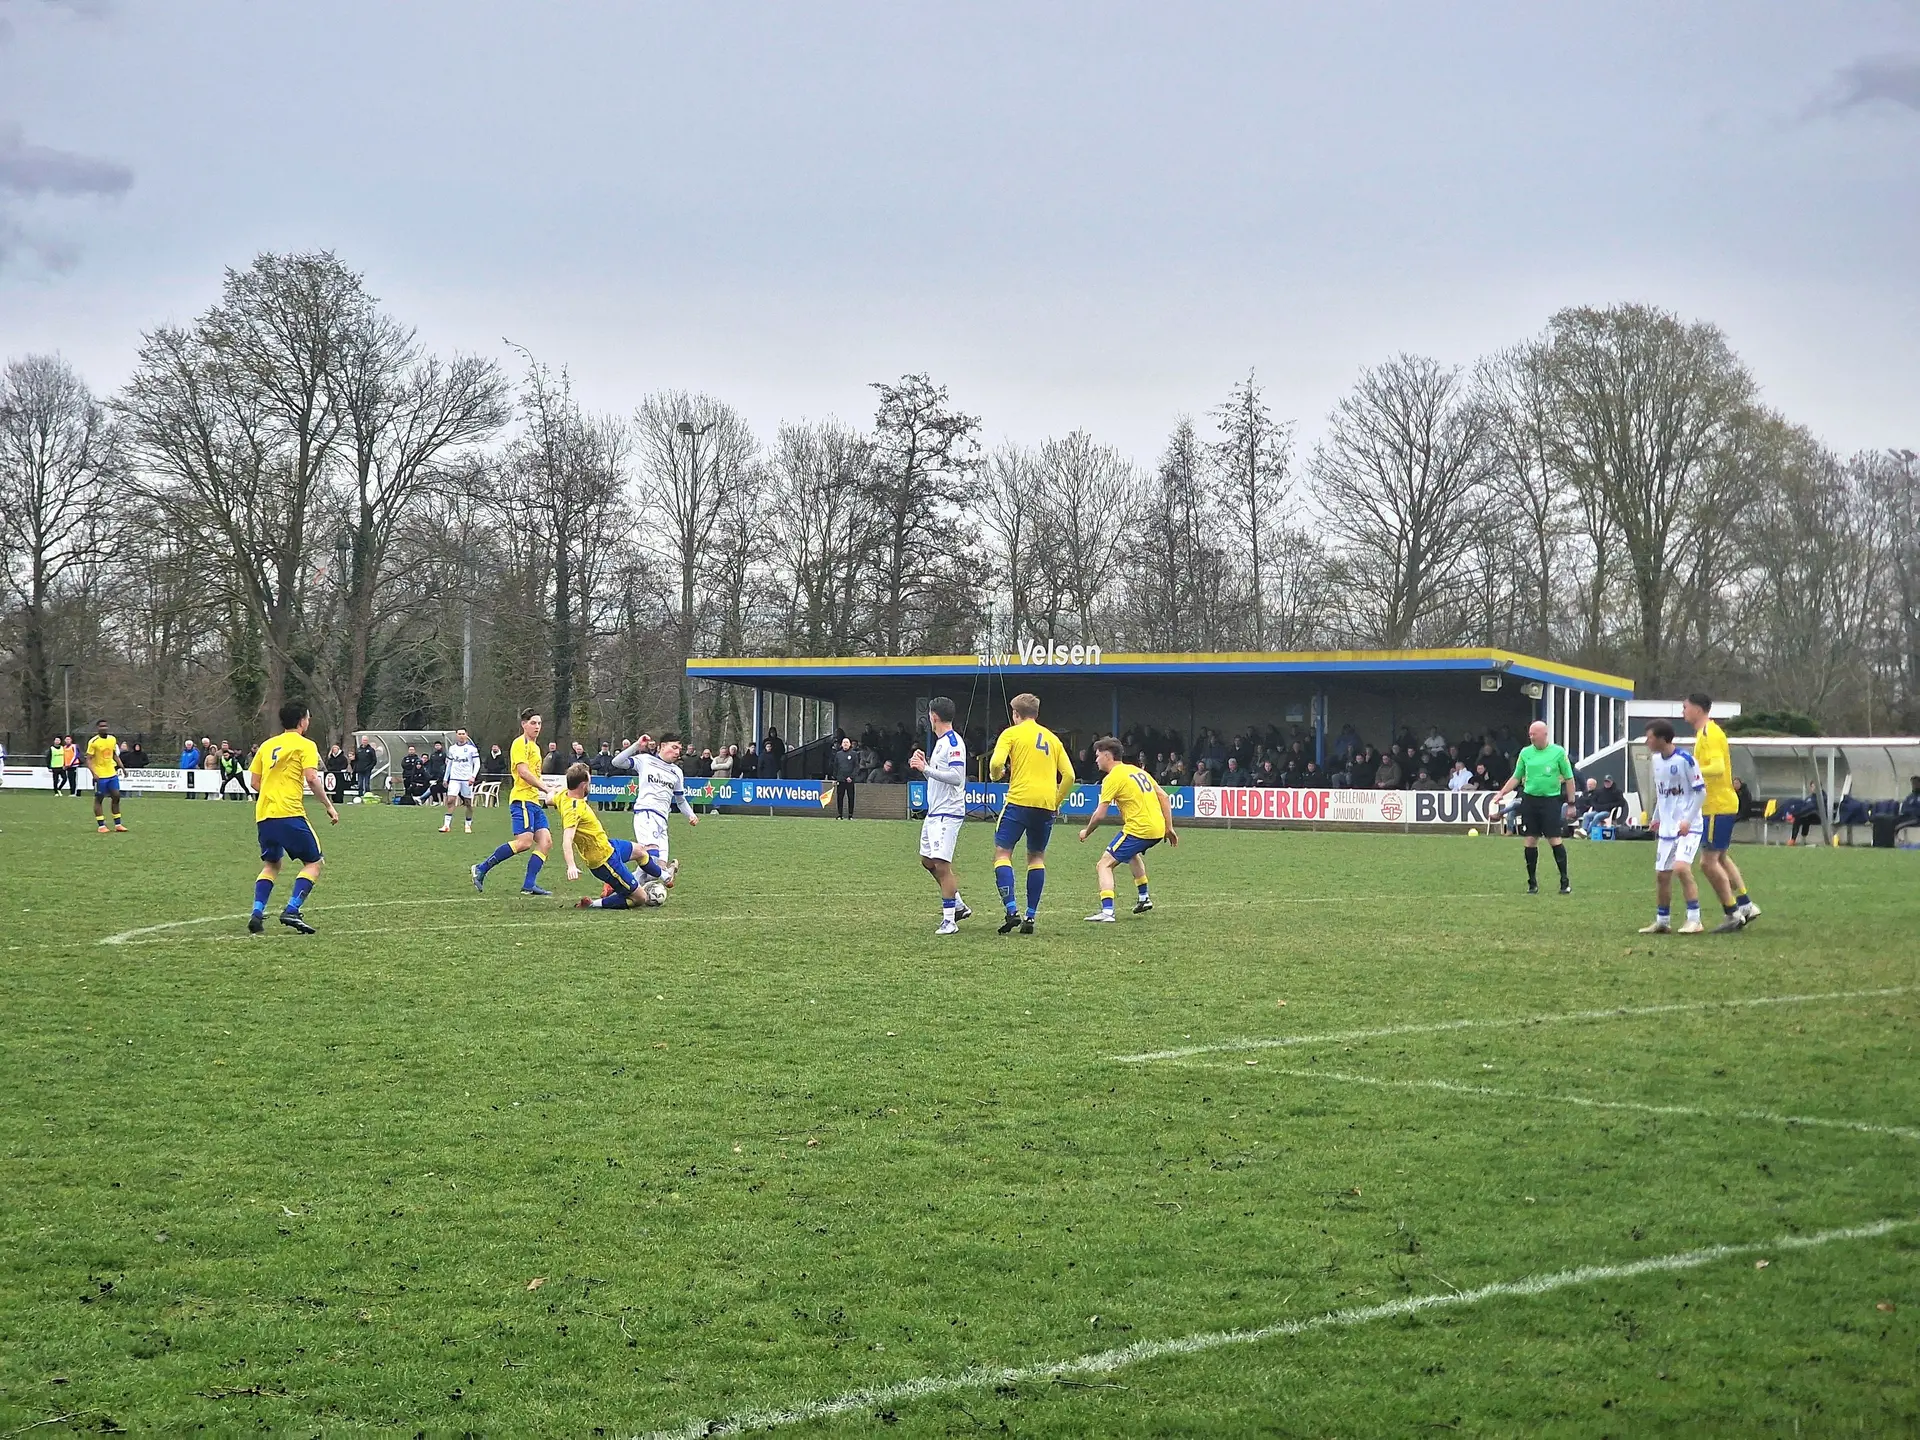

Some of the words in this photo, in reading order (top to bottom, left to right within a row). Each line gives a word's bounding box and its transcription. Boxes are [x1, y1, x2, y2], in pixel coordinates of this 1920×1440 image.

[978, 654, 1011, 667] RKVV
[1017, 639, 1102, 666] Velsen
[1035, 732, 1050, 756] 4
[590, 784, 626, 795] Heineken
[1129, 772, 1152, 793] 18
[683, 785, 703, 797] eken
[756, 785, 783, 799] RKVV
[784, 787, 819, 801] Velsen
[964, 789, 996, 804] elsen
[1333, 790, 1377, 805] STELLENDAM
[1221, 789, 1330, 819] NEDERLOF
